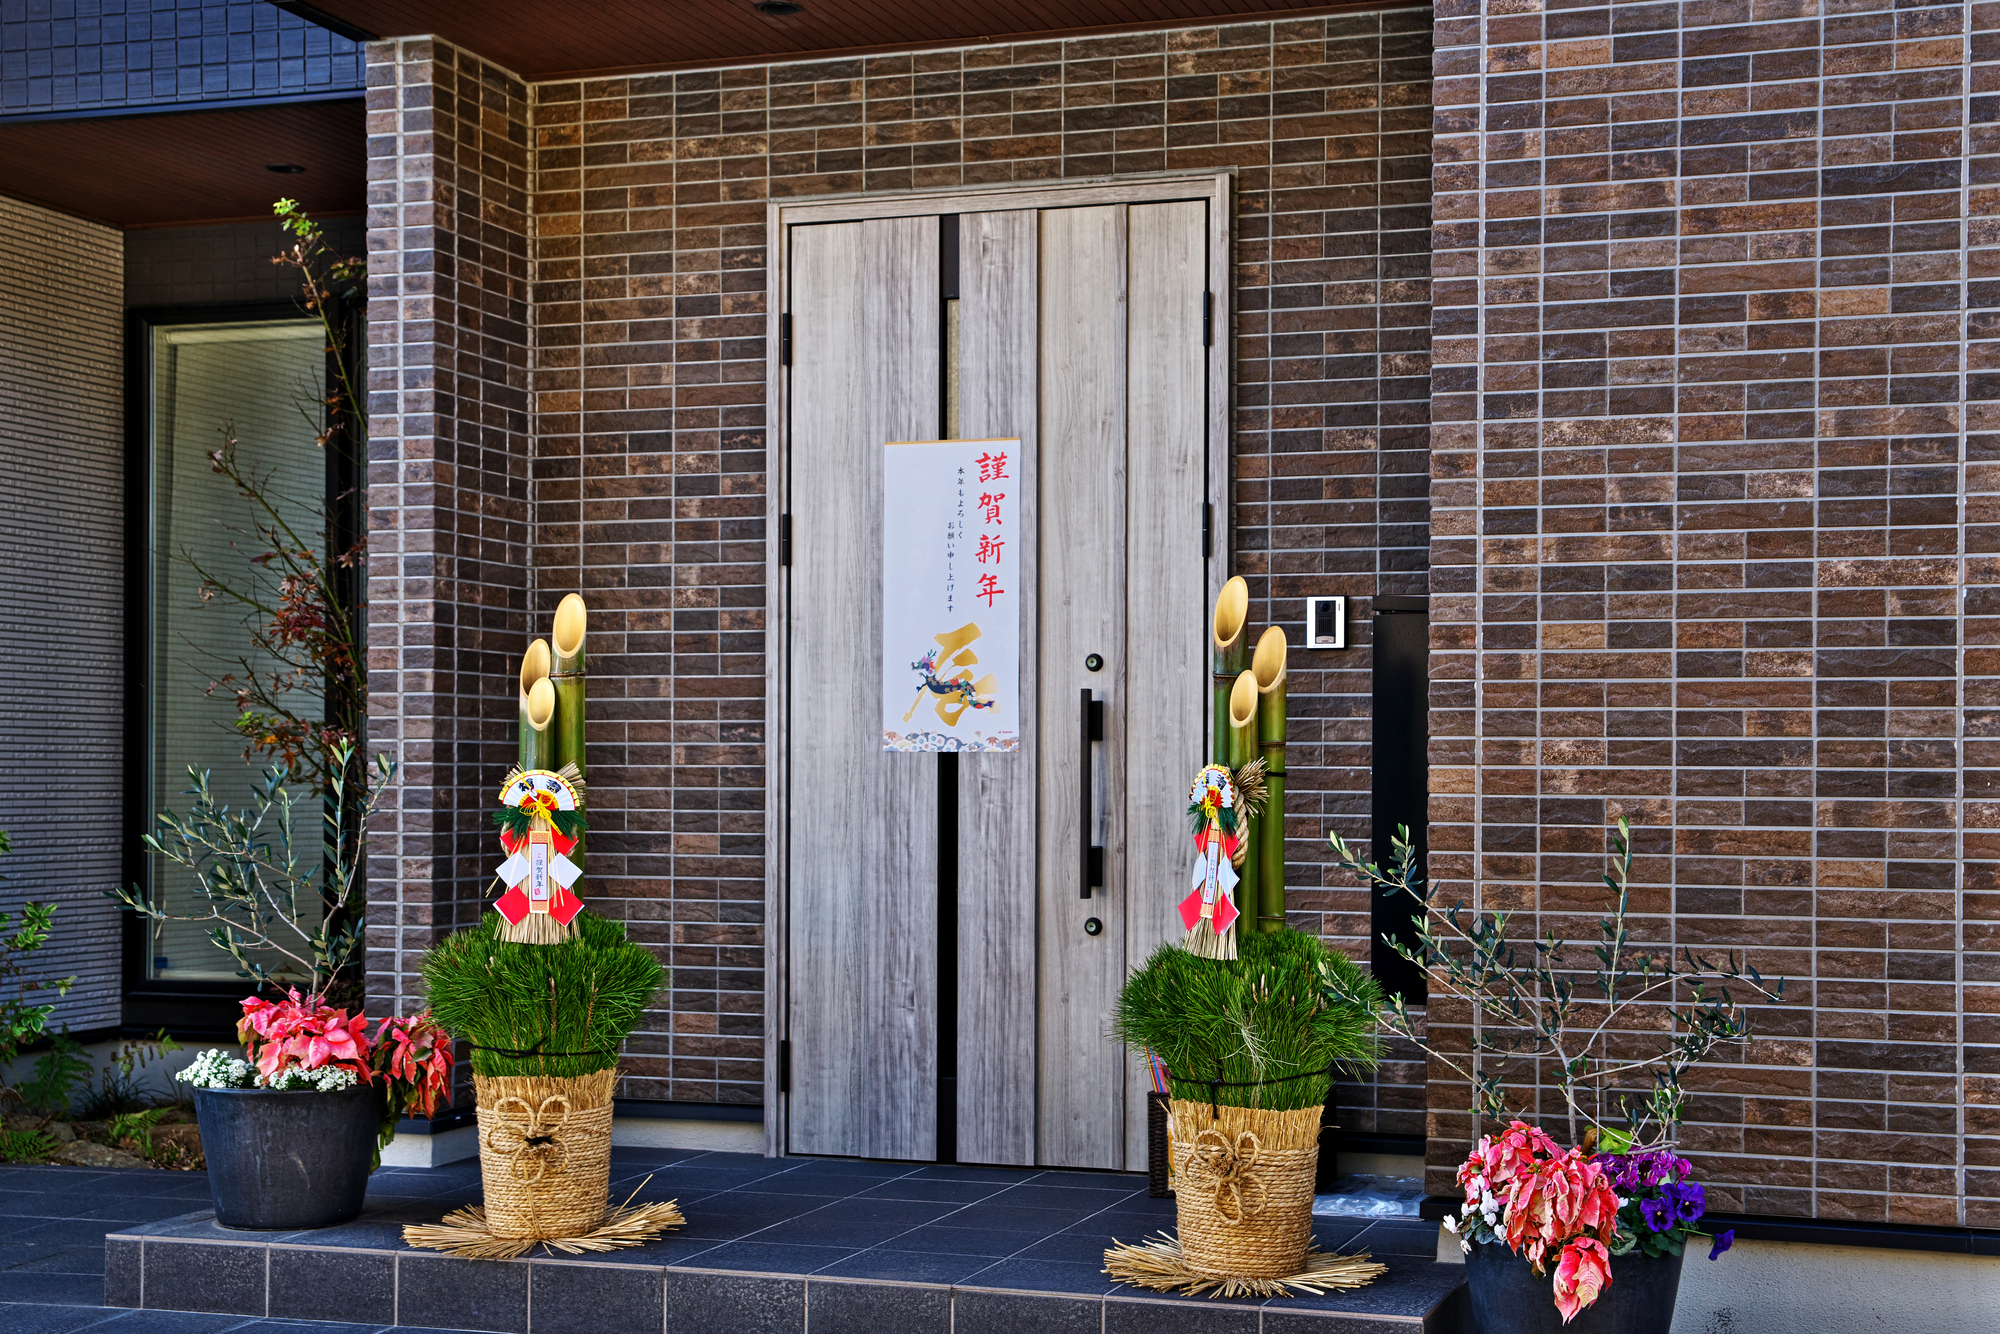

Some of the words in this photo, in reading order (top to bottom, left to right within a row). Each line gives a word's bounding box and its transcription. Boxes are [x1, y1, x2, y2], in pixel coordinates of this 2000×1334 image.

[957, 466, 965, 539] 本年もよろしく
[974, 451, 1010, 608] 謹賀新年
[947, 521, 955, 613] お願い申し上げます
